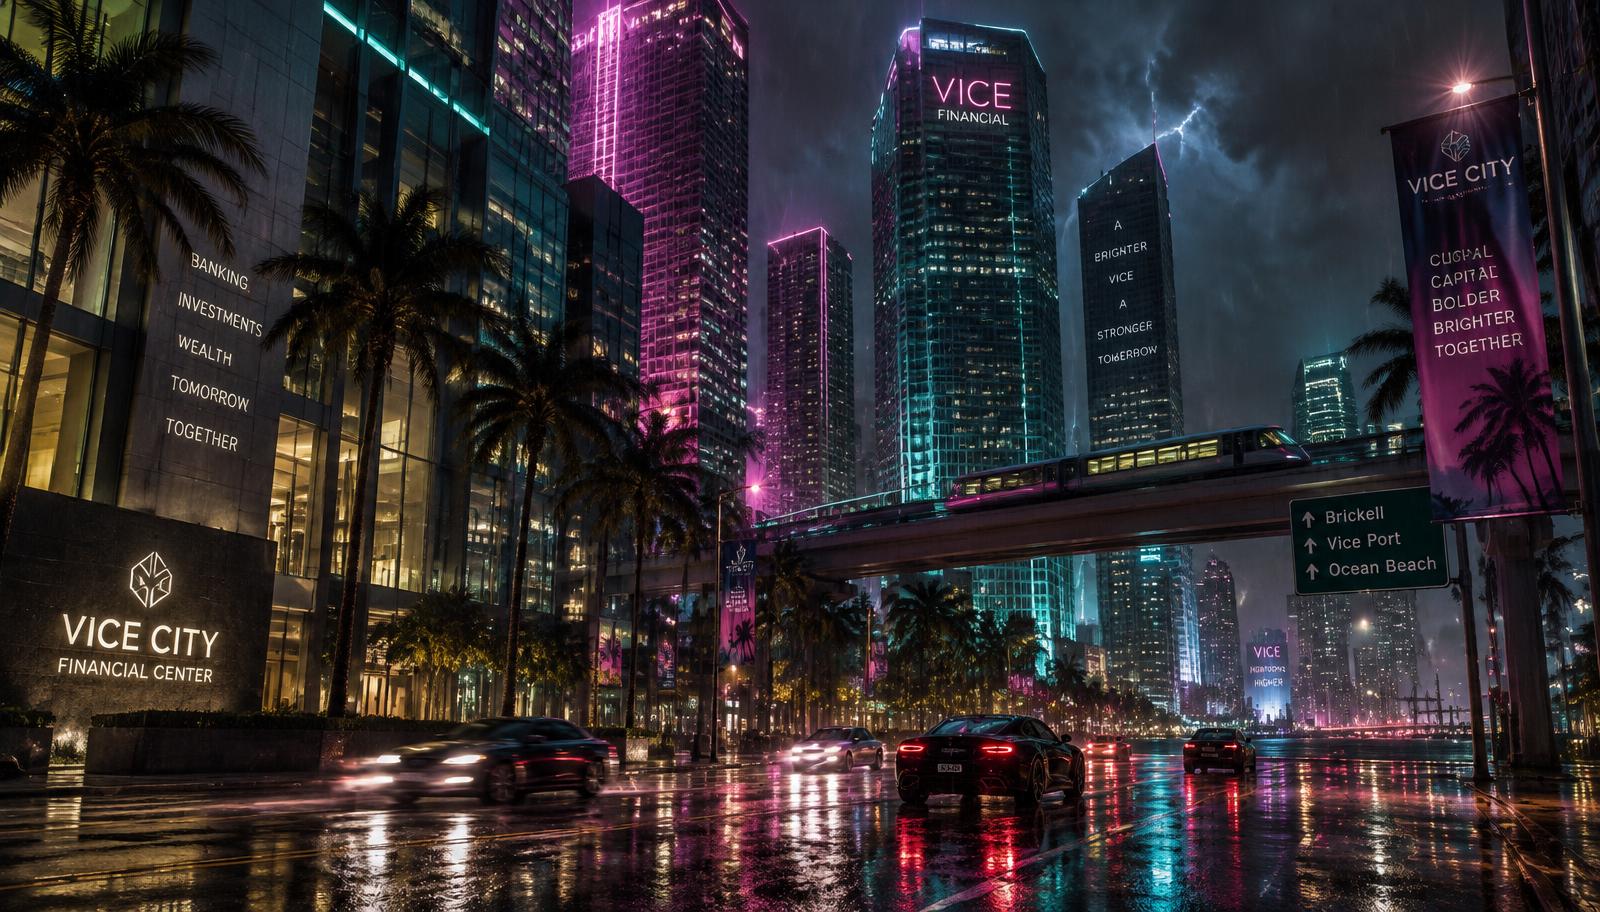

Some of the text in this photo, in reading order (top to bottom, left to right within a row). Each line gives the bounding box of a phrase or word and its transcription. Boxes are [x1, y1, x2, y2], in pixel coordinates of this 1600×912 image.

[932, 75, 1012, 109] VICE
[938, 109, 1009, 126] FINANCIAL
[1407, 169, 1458, 195] VICE
[1465, 156, 1515, 182] CITY
[1114, 220, 1123, 231] A
[1109, 270, 1134, 284] VICE
[1431, 265, 1499, 289] CAPITAL
[1119, 299, 1127, 309] A
[1432, 289, 1501, 312] BOLDER
[178, 291, 263, 338] INVESTMENTS
[1433, 310, 1516, 335] BRIGHTER
[1097, 320, 1153, 340] STRONGER
[178, 334, 232, 367] WEALTH
[1434, 332, 1524, 358] TOGETHER
[171, 374, 249, 413] TOMORROW
[165, 417, 238, 452] TOGETHER
[1325, 505, 1384, 524] Brickell
[1327, 531, 1402, 551] Vice Port
[1329, 556, 1437, 577] Ocean Beach
[63, 613, 219, 658] VICE CITY
[1253, 645, 1281, 659] VICE
[58, 657, 213, 683] FINANCIAL CENTER
